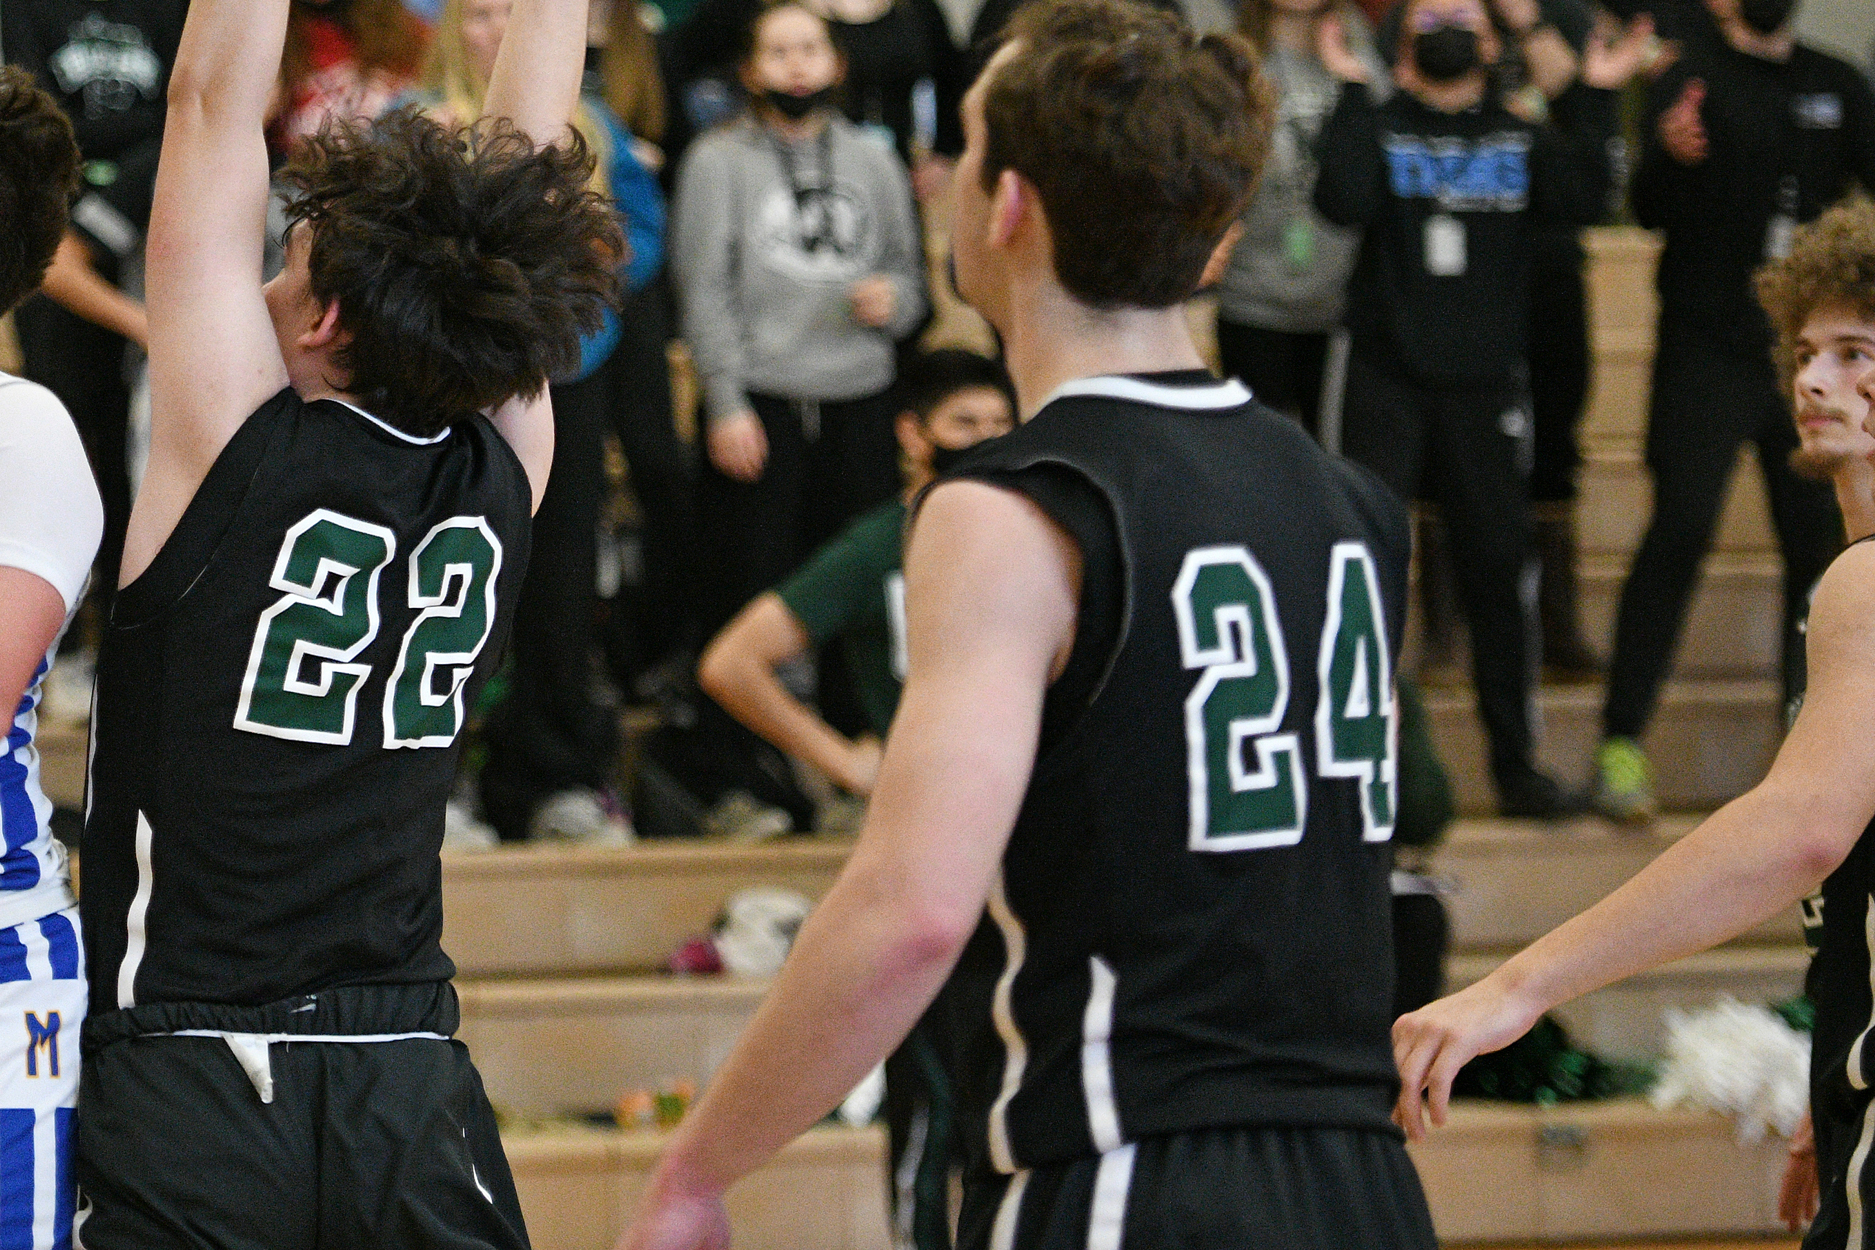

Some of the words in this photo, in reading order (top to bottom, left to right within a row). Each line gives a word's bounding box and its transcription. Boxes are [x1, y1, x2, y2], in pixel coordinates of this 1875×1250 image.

[233, 507, 503, 750] 22
[1171, 541, 1398, 852] 24
[23, 1010, 63, 1079] M
